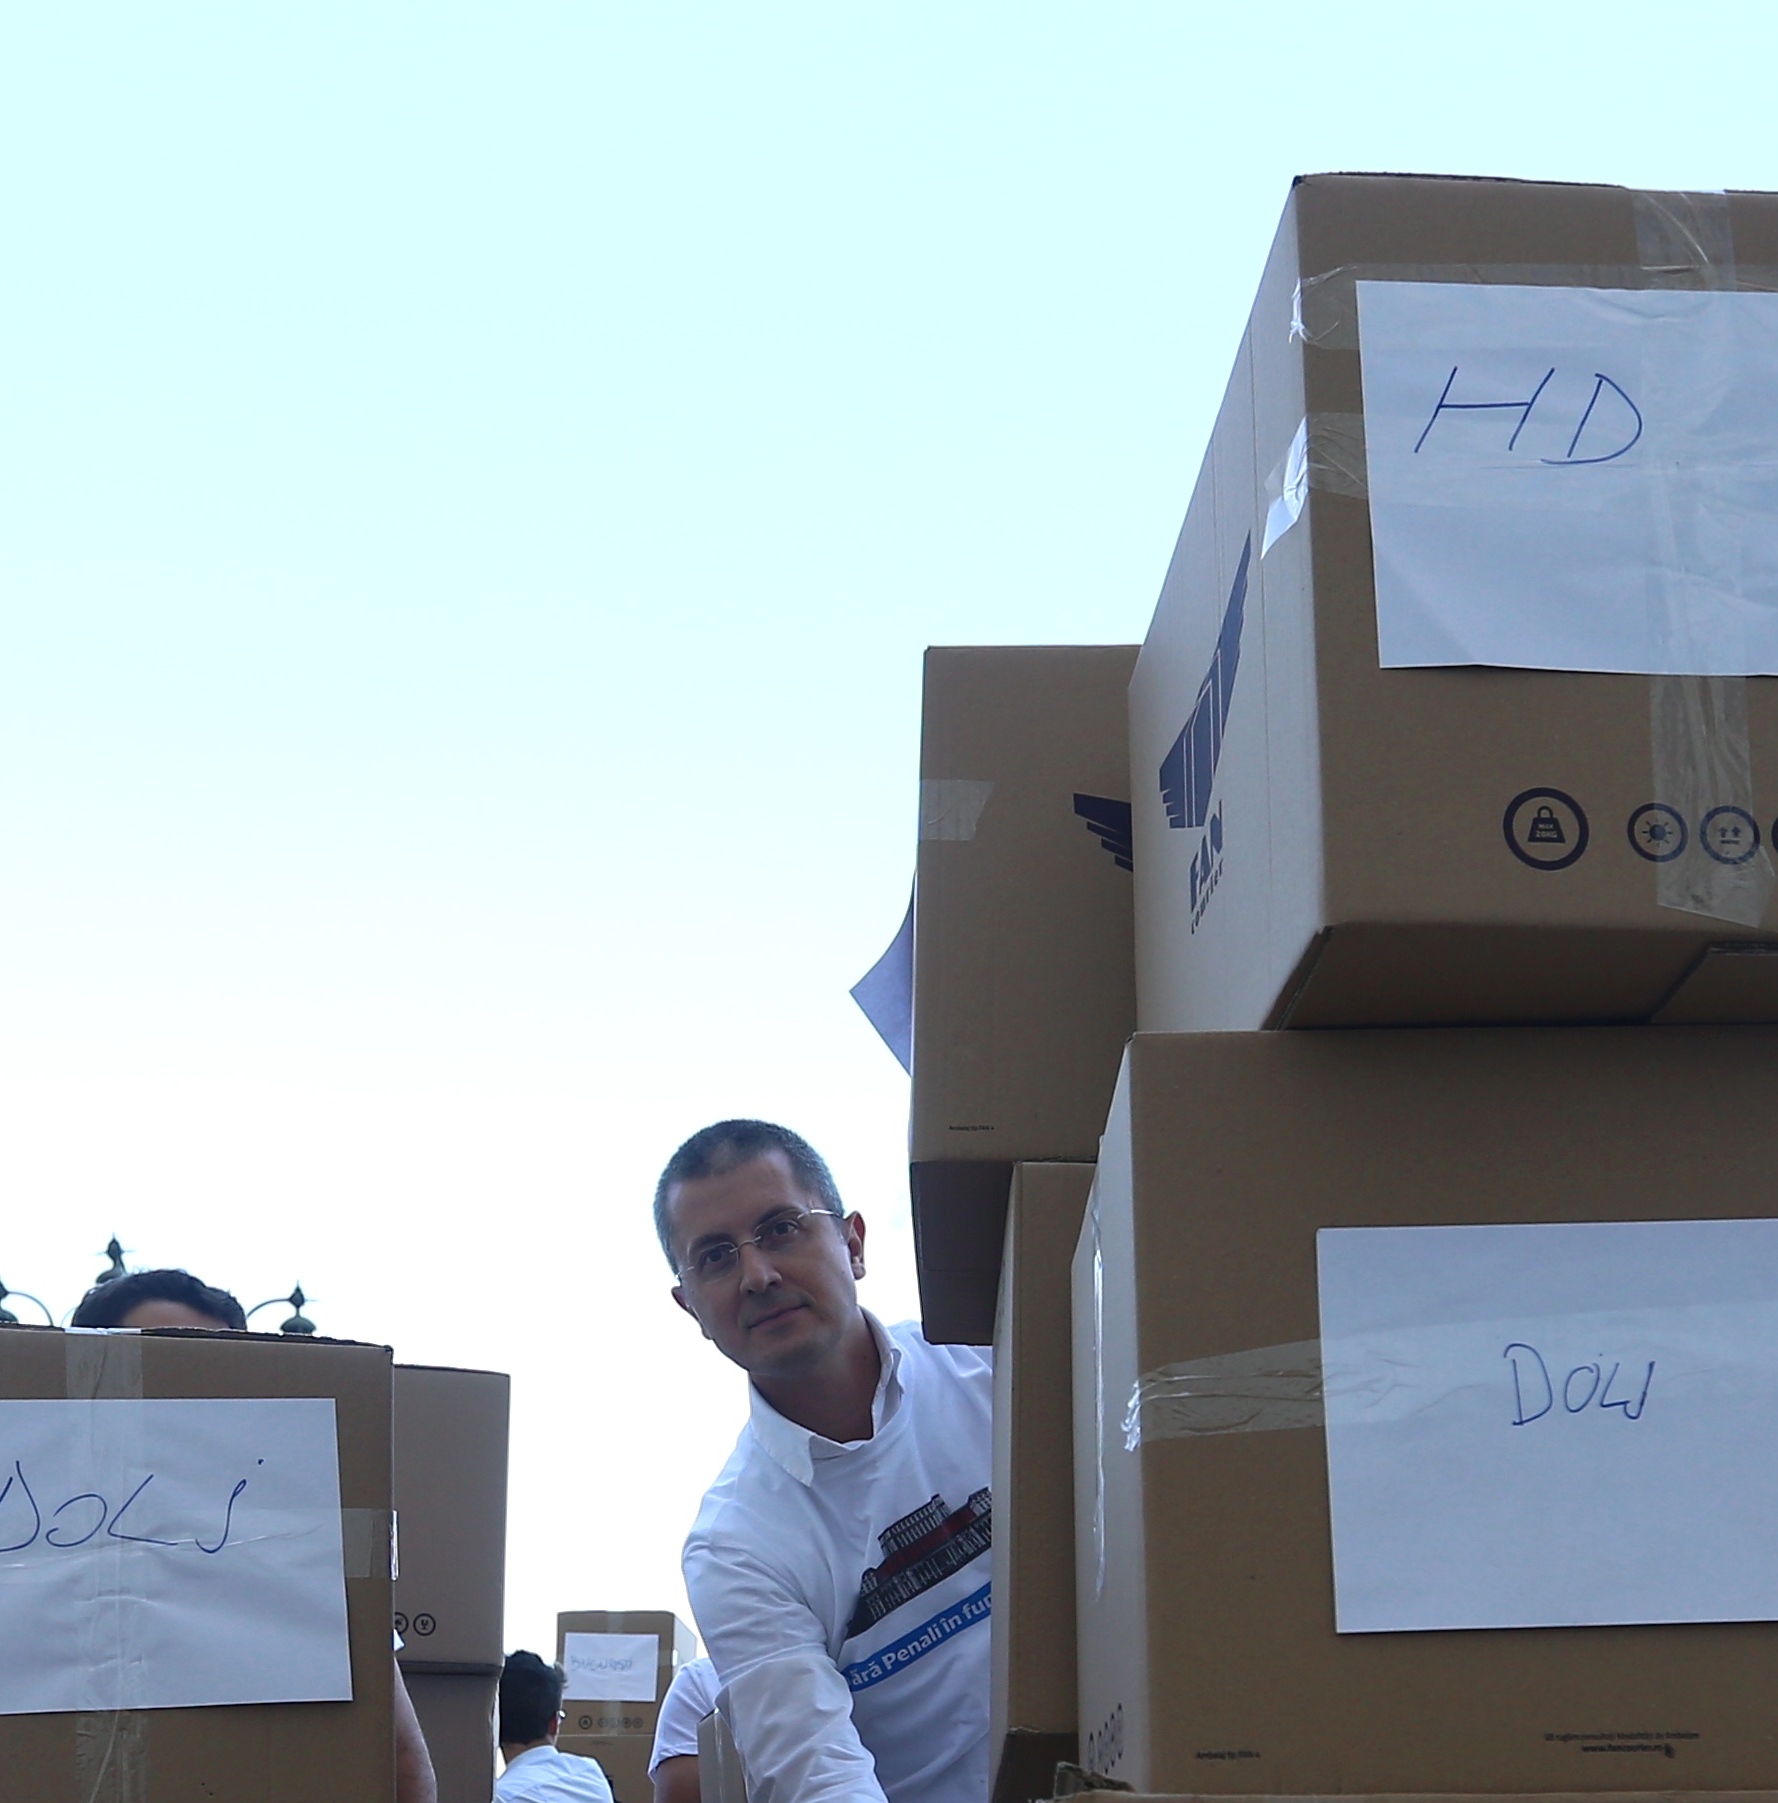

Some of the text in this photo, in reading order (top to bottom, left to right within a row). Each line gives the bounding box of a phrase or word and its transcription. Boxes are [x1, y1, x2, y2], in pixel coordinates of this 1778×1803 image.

[1414, 366, 1644, 465] HD
[1189, 799, 1223, 914] FAN
[848, 1660, 883, 1687] ără
[881, 1624, 943, 1671] Penali
[938, 1617, 963, 1634] în
